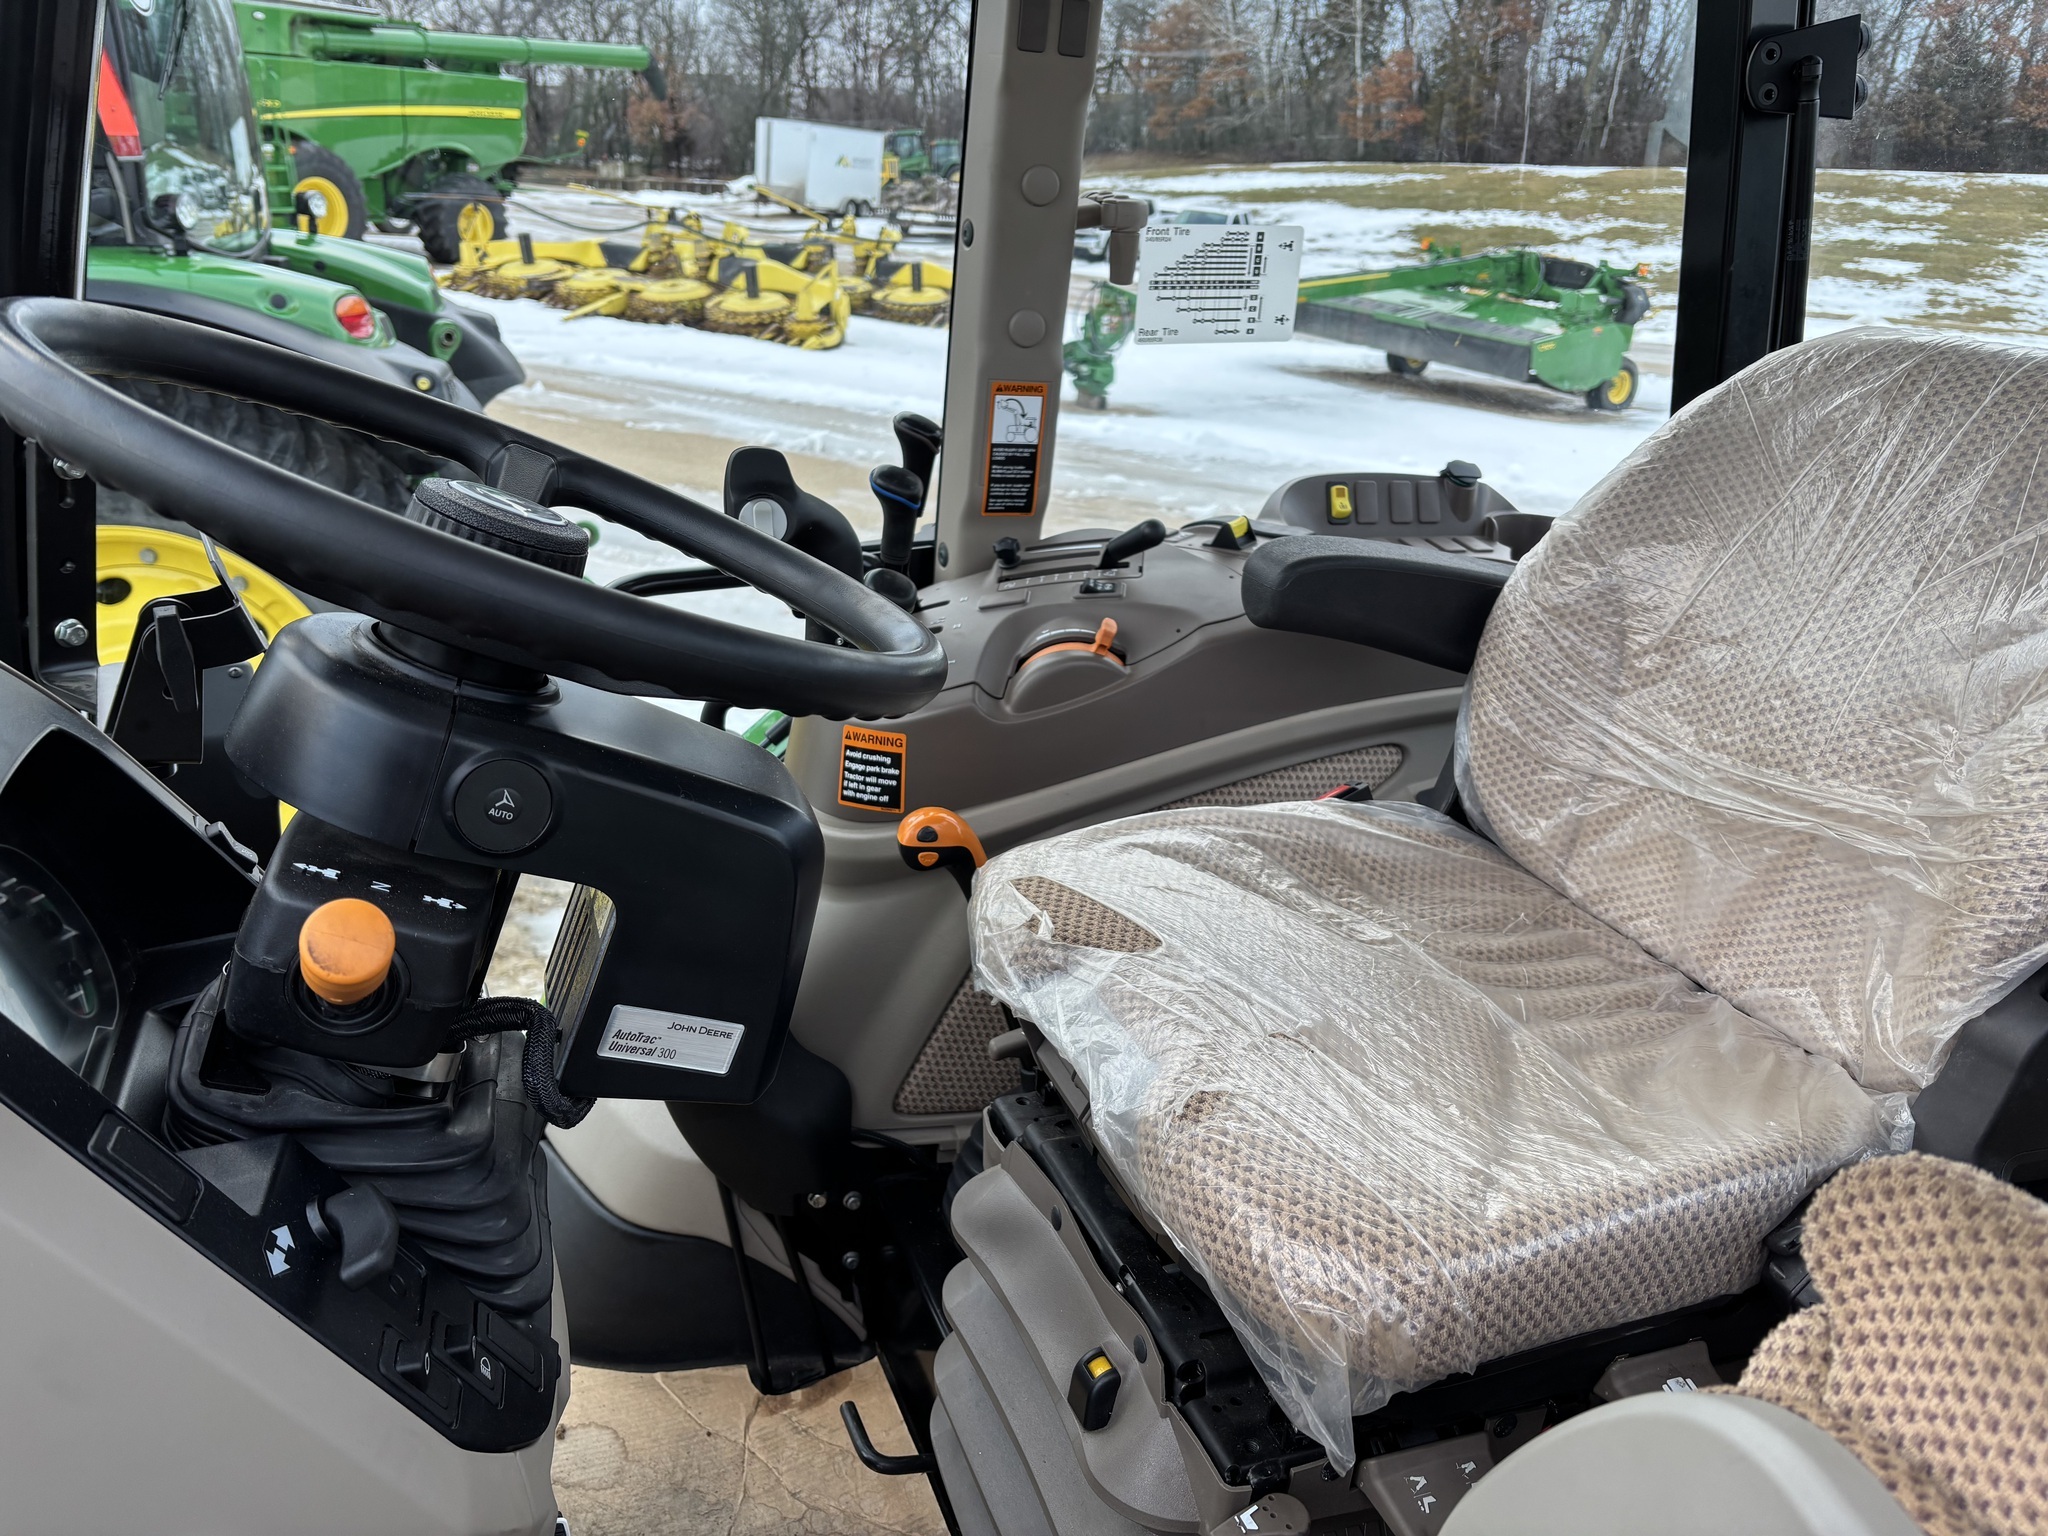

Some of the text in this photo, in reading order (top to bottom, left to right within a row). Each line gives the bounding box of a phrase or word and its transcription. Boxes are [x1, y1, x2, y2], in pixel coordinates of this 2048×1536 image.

[1146, 226, 1190, 236] Front Tire
[1138, 328, 1179, 336] Rear Tire
[1003, 384, 1044, 394] WARNING
[852, 731, 904, 748] WARNING
[845, 749, 892, 764] Avoid crushing
[844, 760, 900, 775] Engage park brake
[844, 770, 864, 781] Tractor
[878, 778, 898, 786] move
[848, 780, 858, 789] left
[866, 785, 882, 793] gear
[842, 789, 855, 797] with
[856, 792, 878, 802] engine
[488, 808, 514, 820] AUTO
[667, 1022, 734, 1040] JOHN DEERE
[608, 1040, 677, 1060] Universal 300
